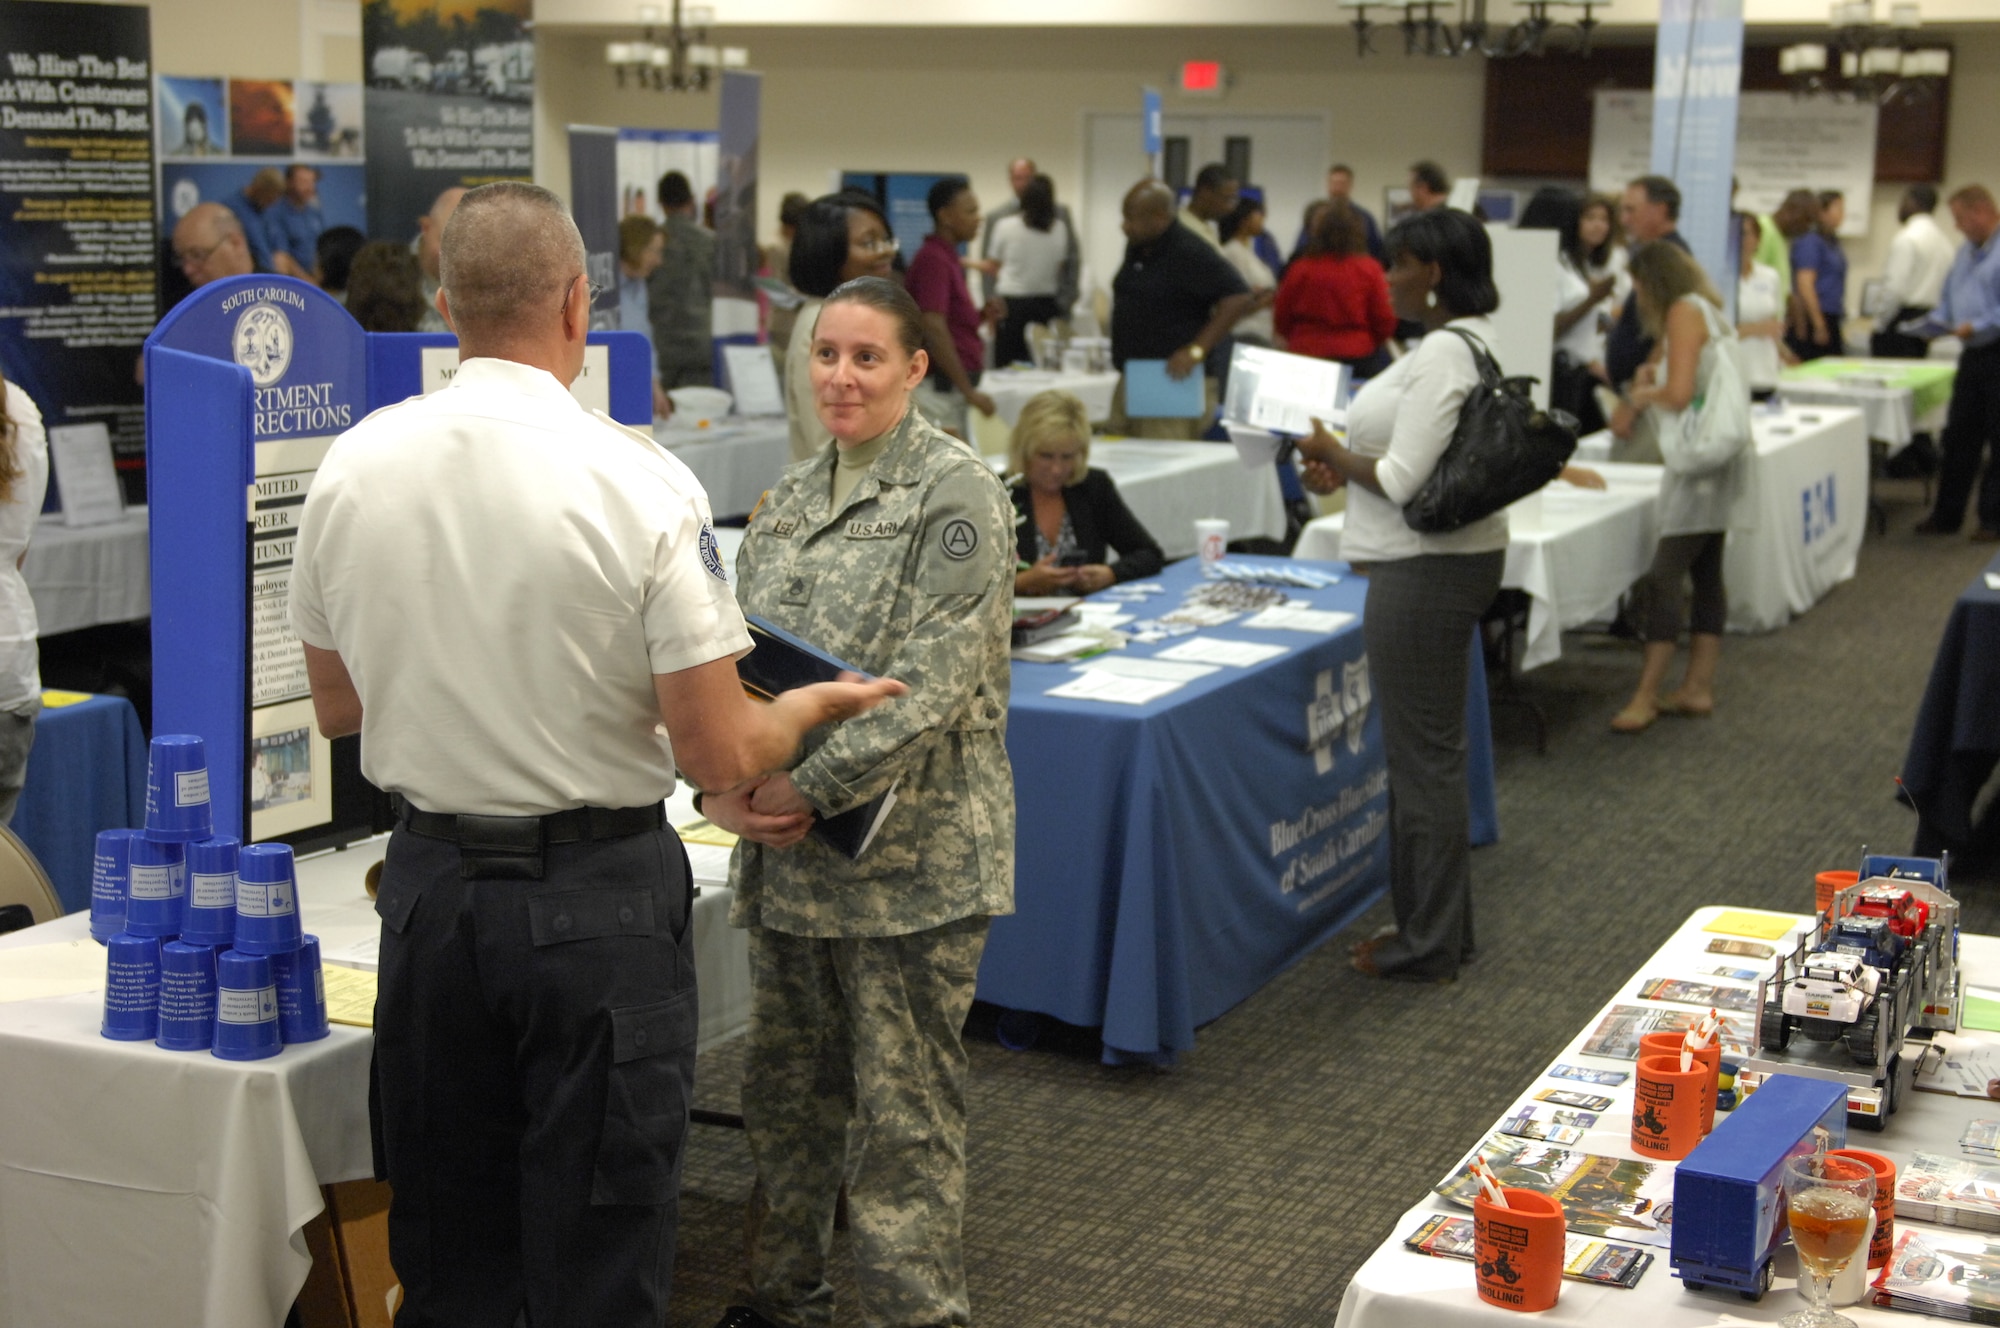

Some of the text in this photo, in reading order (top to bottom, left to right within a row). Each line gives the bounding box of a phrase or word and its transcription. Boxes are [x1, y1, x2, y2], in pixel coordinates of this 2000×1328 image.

[8, 52, 148, 80] We Hire The Best
[17, 80, 58, 102] With
[1, 106, 76, 129] Demand
[77, 107, 114, 130] The
[221, 287, 306, 315] SOUTH CAROLINA
[254, 382, 333, 411] RTMENT
[254, 404, 351, 436] RECTIONS
[255, 479, 299, 497] MITED
[254, 512, 289, 529] REER
[773, 519, 793, 536] LEE
[949, 525, 970, 548] A
[254, 541, 297, 560] TUNIT
[700, 535, 717, 571] CAROLINA
